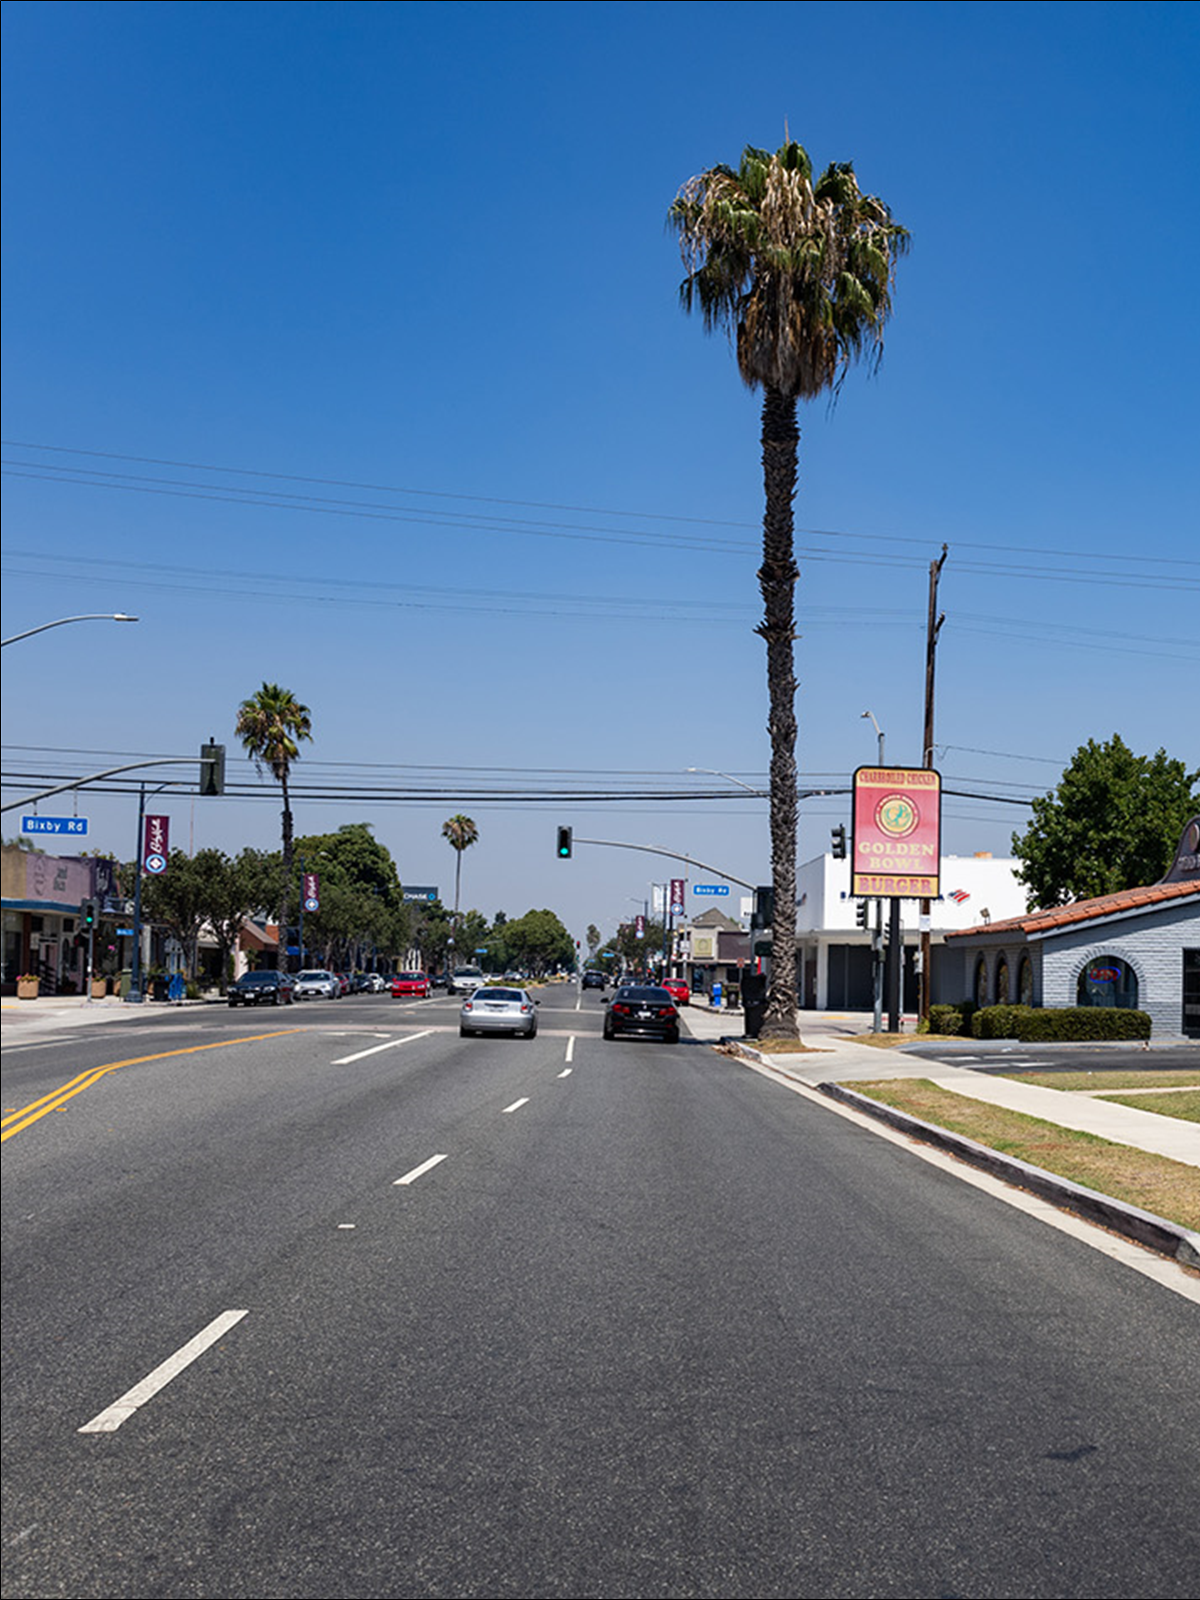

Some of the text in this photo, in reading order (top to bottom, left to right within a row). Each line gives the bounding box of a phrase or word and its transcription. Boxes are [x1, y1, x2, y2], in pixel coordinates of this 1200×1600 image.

[27, 819, 83, 833] Bixby Rd
[858, 841, 935, 857] GOLDEN
[869, 857, 925, 872] BOWL
[857, 877, 933, 895] BURGER
